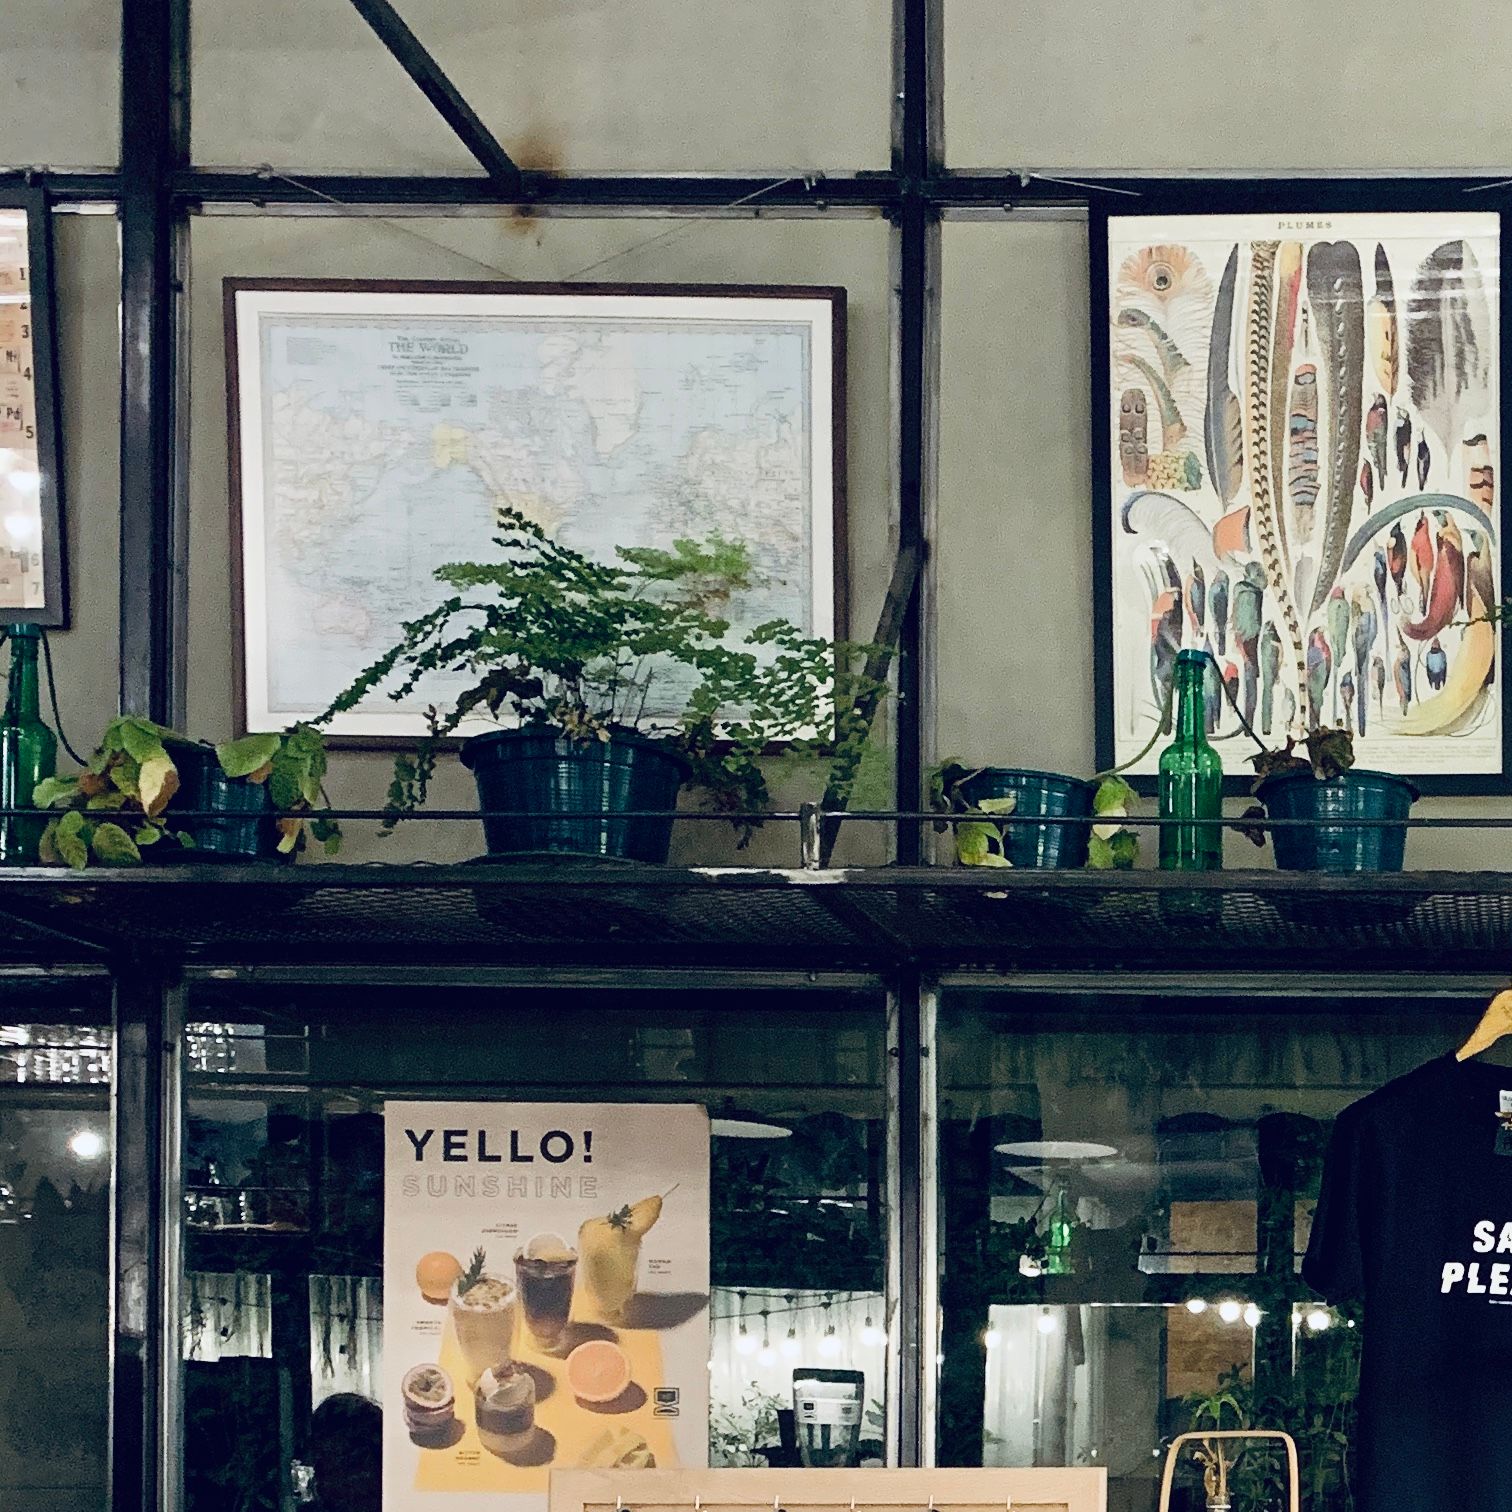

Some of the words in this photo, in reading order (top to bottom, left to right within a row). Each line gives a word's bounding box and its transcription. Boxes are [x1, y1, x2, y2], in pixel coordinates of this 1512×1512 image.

[1278, 221, 1333, 230] PLUMES
[21, 324, 30, 339] 3
[389, 342, 413, 353] THE
[419, 343, 468, 355] WORLD
[23, 367, 31, 381] 4
[25, 425, 34, 439] 5
[405, 1129, 593, 1163] YELLO!
[402, 1175, 598, 1198] SUNSHINE
